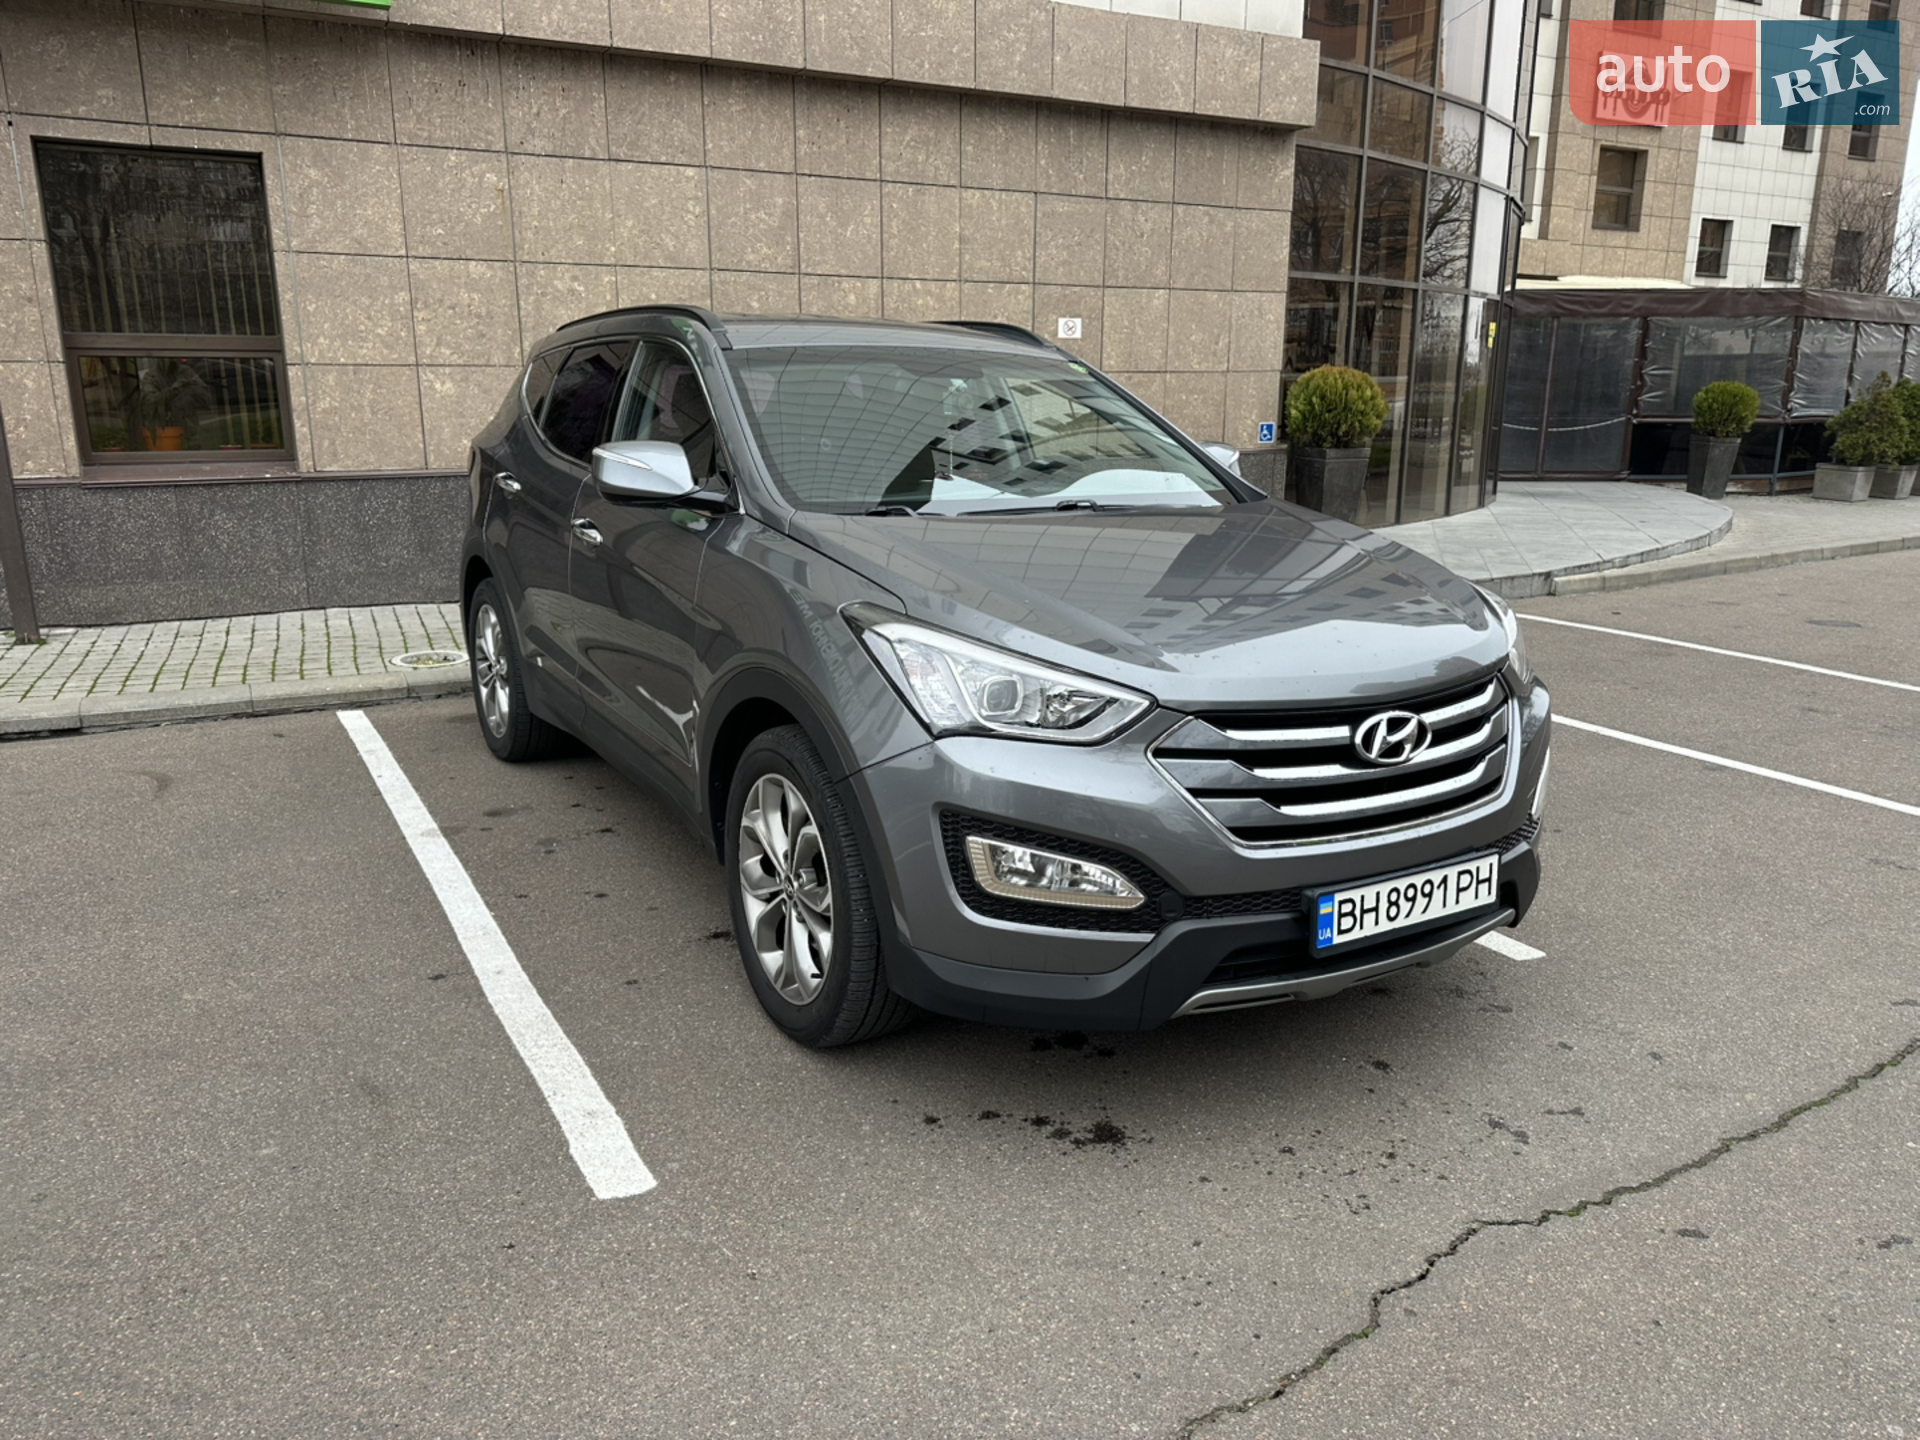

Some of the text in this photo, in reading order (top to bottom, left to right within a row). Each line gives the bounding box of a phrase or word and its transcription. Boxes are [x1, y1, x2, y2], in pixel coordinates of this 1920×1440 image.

[1336, 862, 1494, 936] BH 8991 PH
[1318, 927, 1332, 940] UA
